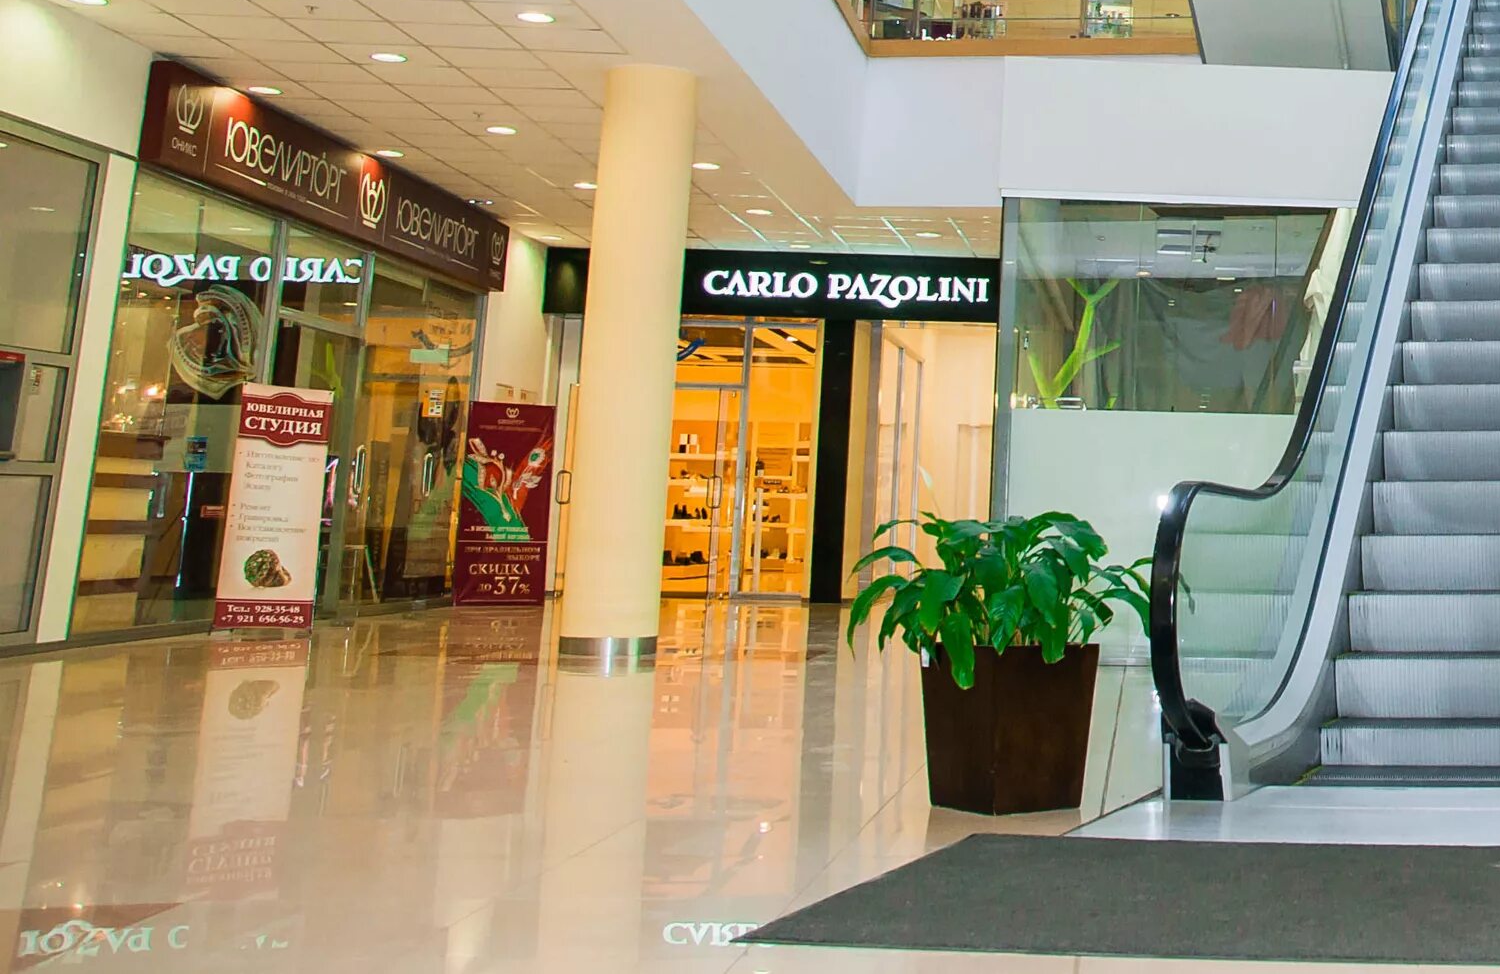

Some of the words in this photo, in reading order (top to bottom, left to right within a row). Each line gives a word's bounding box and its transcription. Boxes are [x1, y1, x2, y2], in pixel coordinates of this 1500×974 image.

[703, 269, 819, 298] CARLO
[827, 273, 990, 309] PAZOLINI
[246, 402, 324, 419] ЮВЕЛИРНАЯ
[244, 415, 322, 435] СТУДИЯ
[469, 563, 530, 575] СКИДКА
[255, 605, 300, 614] 928-35-48
[237, 615, 254, 624] 921
[259, 614, 304, 624] 656-56-25
